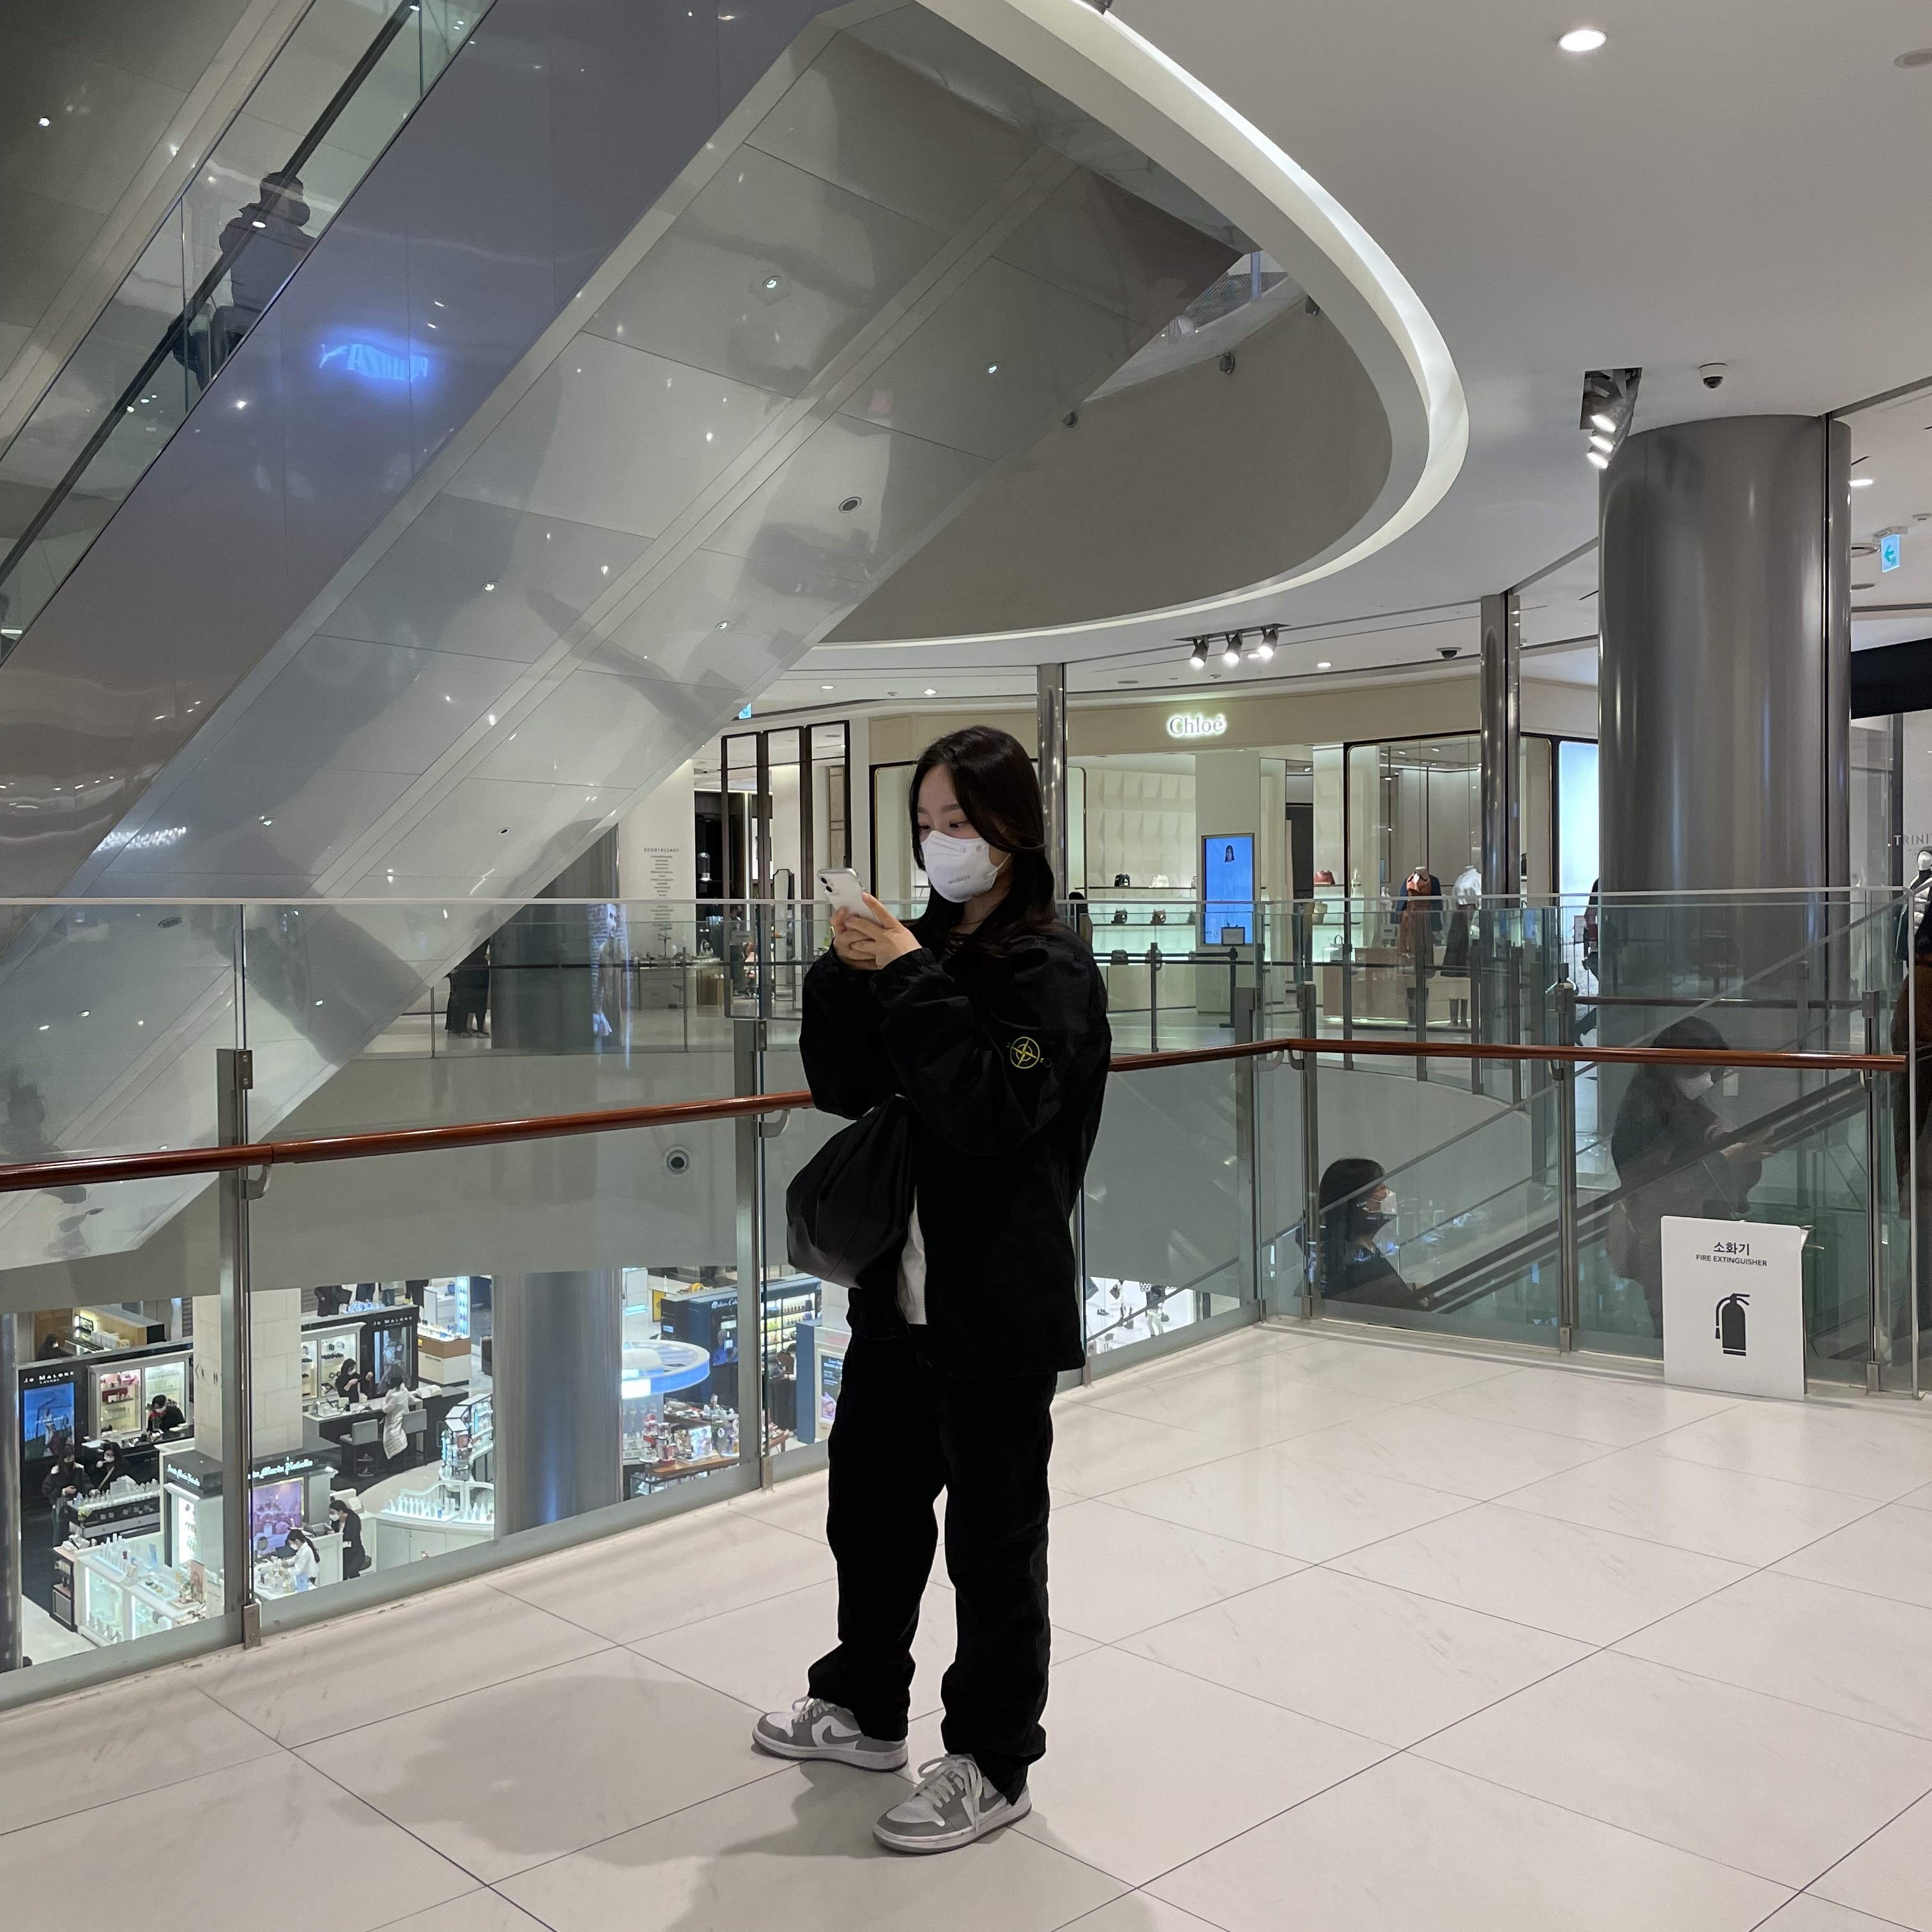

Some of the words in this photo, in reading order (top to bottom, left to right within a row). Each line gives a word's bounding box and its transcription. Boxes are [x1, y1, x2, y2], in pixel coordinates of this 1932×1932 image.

[1169, 716, 1223, 735] Chloé
[1894, 833, 1932, 846] TRINI
[1713, 1242, 1749, 1255] 소화기
[1713, 1255, 1767, 1266] EXTINGUISHER
[39, 1371, 74, 1380] MALONE
